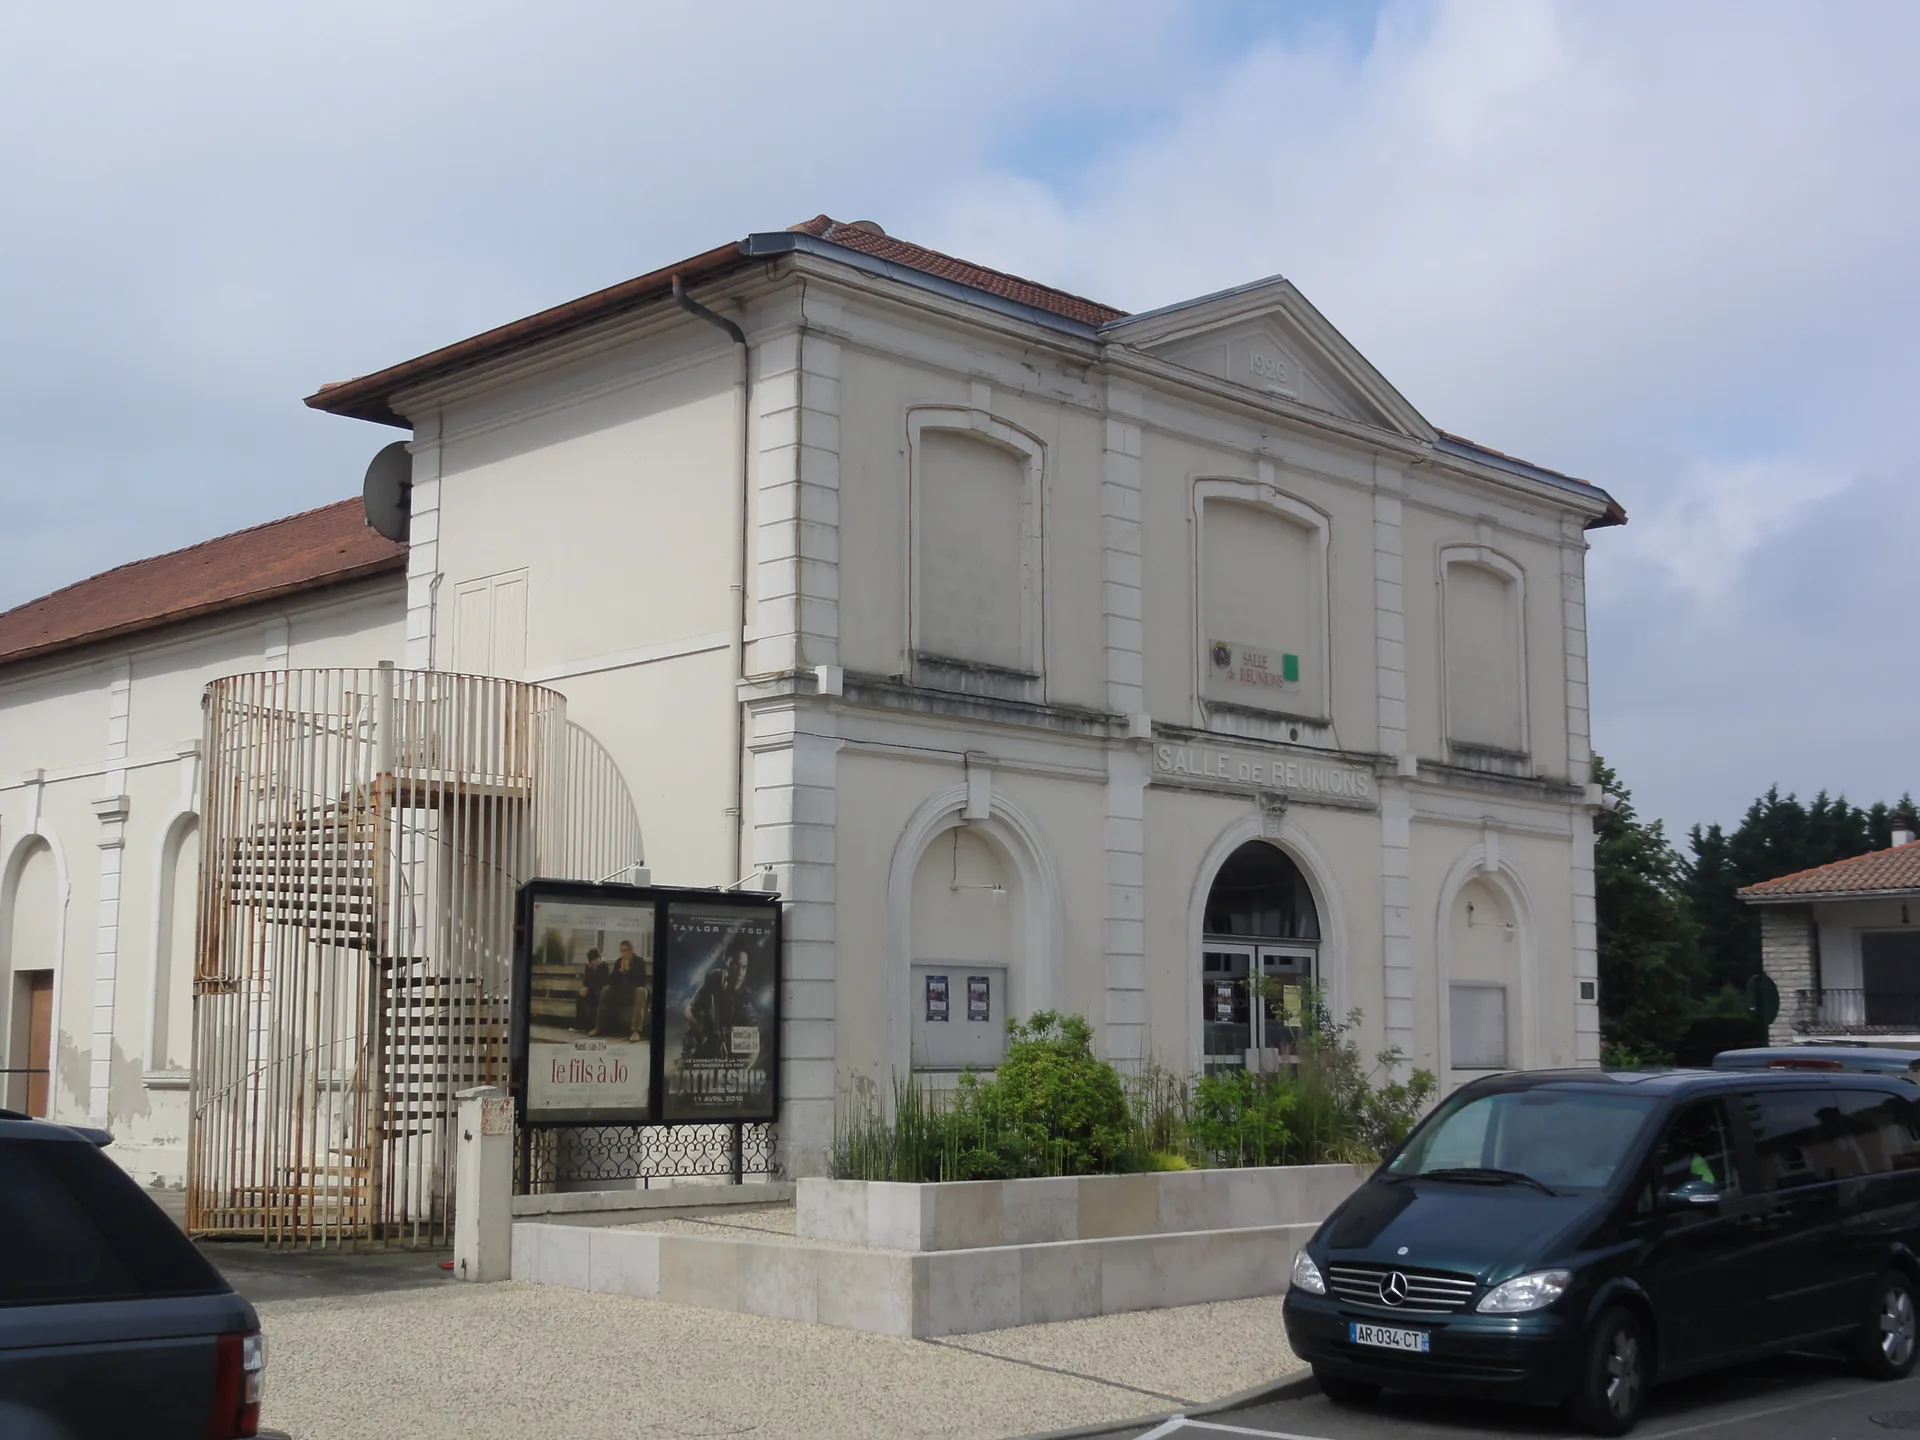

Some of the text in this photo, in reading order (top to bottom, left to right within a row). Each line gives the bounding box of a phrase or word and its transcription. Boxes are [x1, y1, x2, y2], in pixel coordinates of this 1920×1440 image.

[1243, 651, 1268, 669] SALLE
[1228, 666, 1236, 680] de
[1157, 744, 1230, 779] SALLE
[1272, 761, 1369, 797] REUNIONS
[672, 924, 719, 933] TAYLOR
[551, 1057, 628, 1084] le fils à Jo
[1358, 1325, 1420, 1349] AR-034-CT
